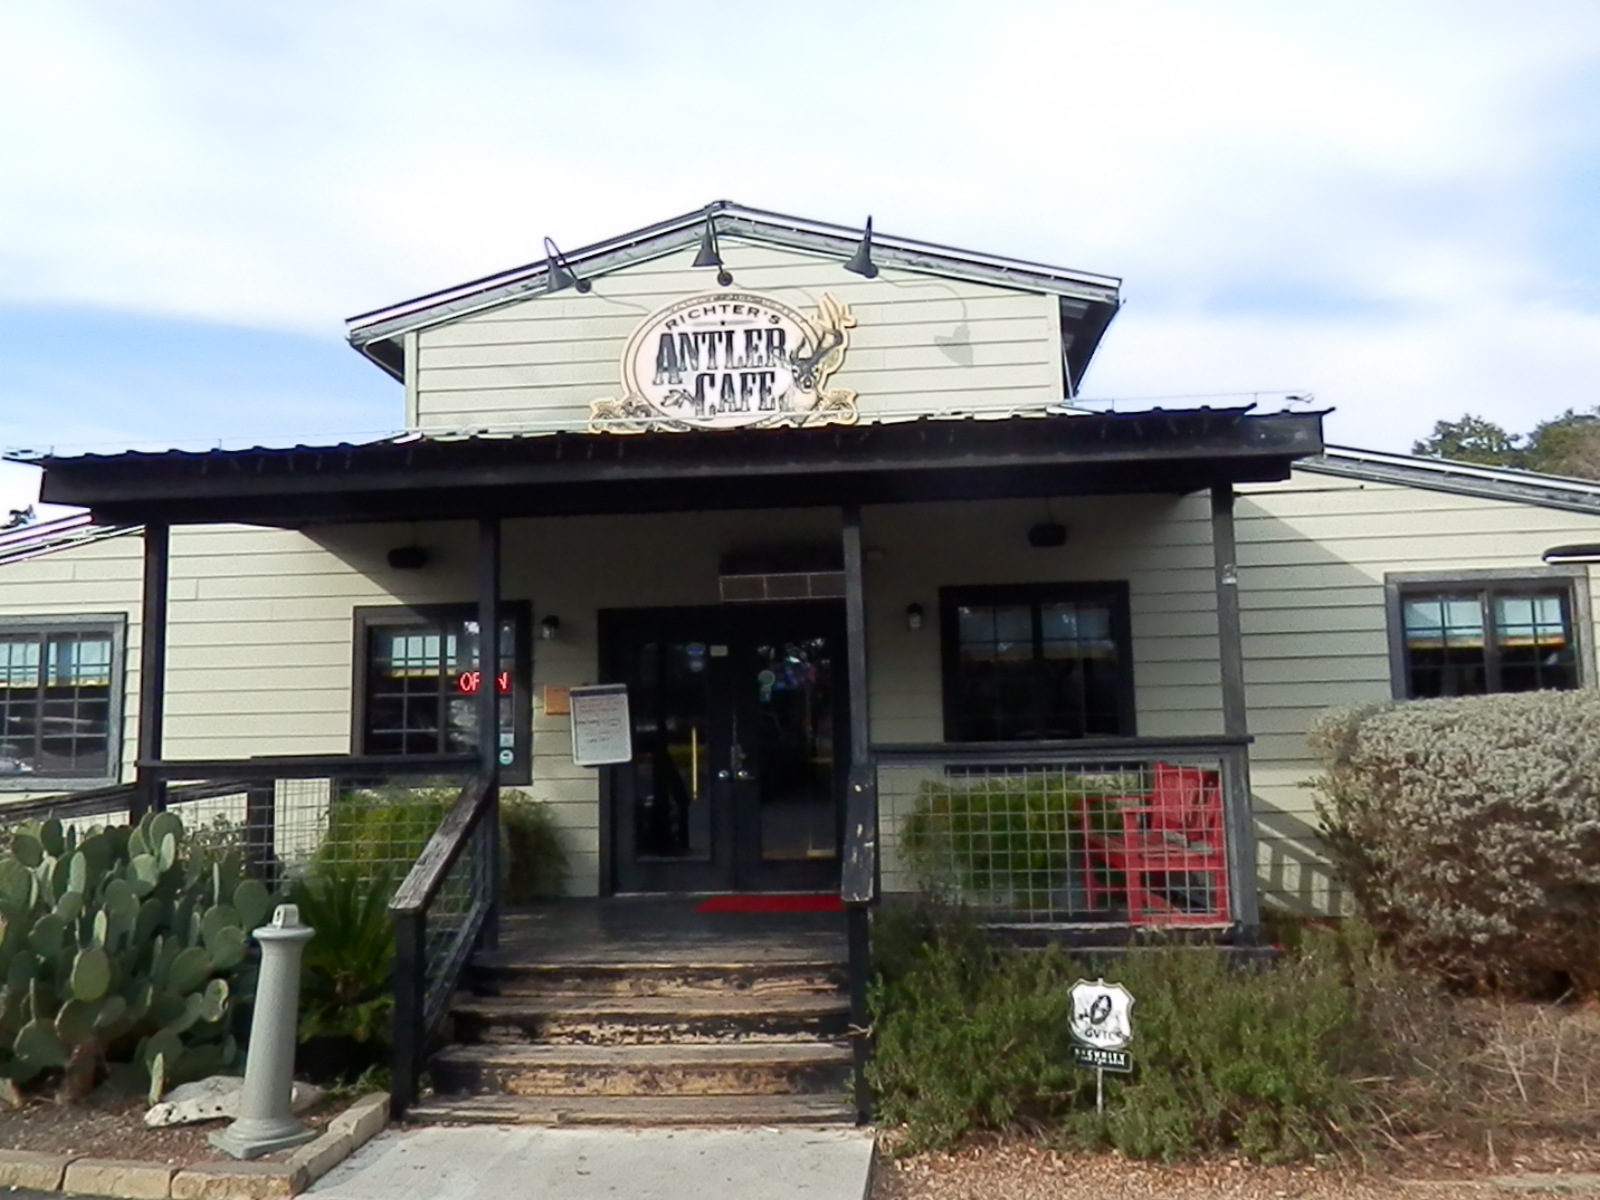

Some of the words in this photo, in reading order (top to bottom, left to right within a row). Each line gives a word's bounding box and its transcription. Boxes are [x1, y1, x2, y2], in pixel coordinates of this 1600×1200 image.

[665, 304, 781, 330] RICHTER'S
[653, 327, 787, 386] ANTLER
[694, 371, 777, 420] CAFE
[460, 671, 508, 691] OPN
